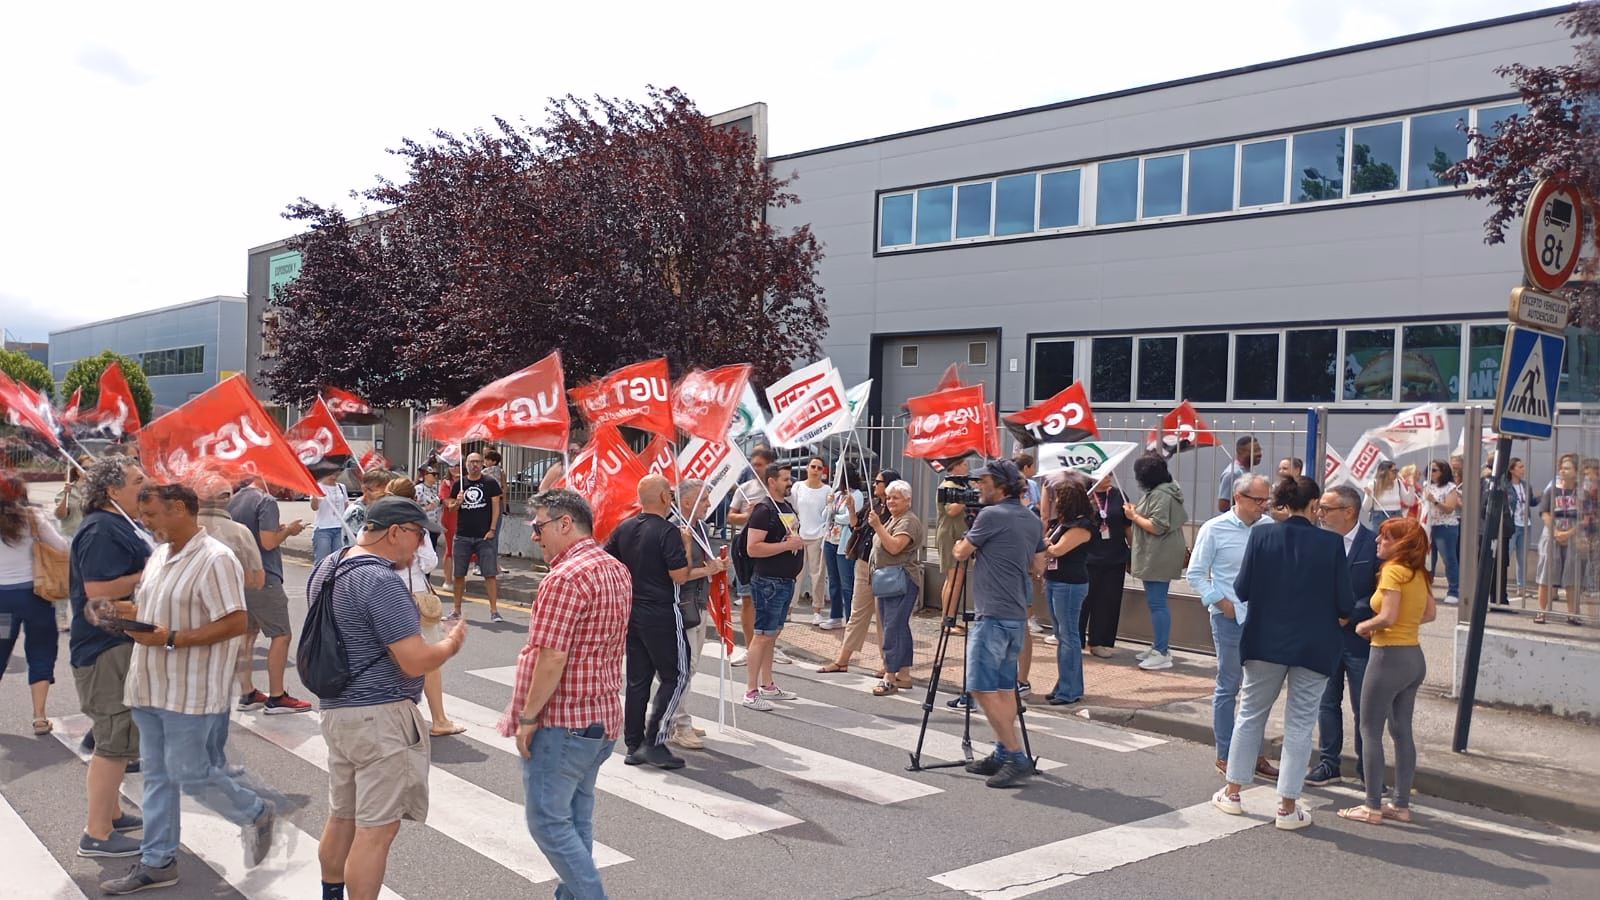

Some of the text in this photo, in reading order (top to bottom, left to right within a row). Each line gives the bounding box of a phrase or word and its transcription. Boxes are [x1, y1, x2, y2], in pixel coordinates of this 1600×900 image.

[1541, 234, 1563, 270] 8t
[1522, 294, 1543, 308] EXCEPTO
[1528, 309, 1558, 324] AUTOESCUELA
